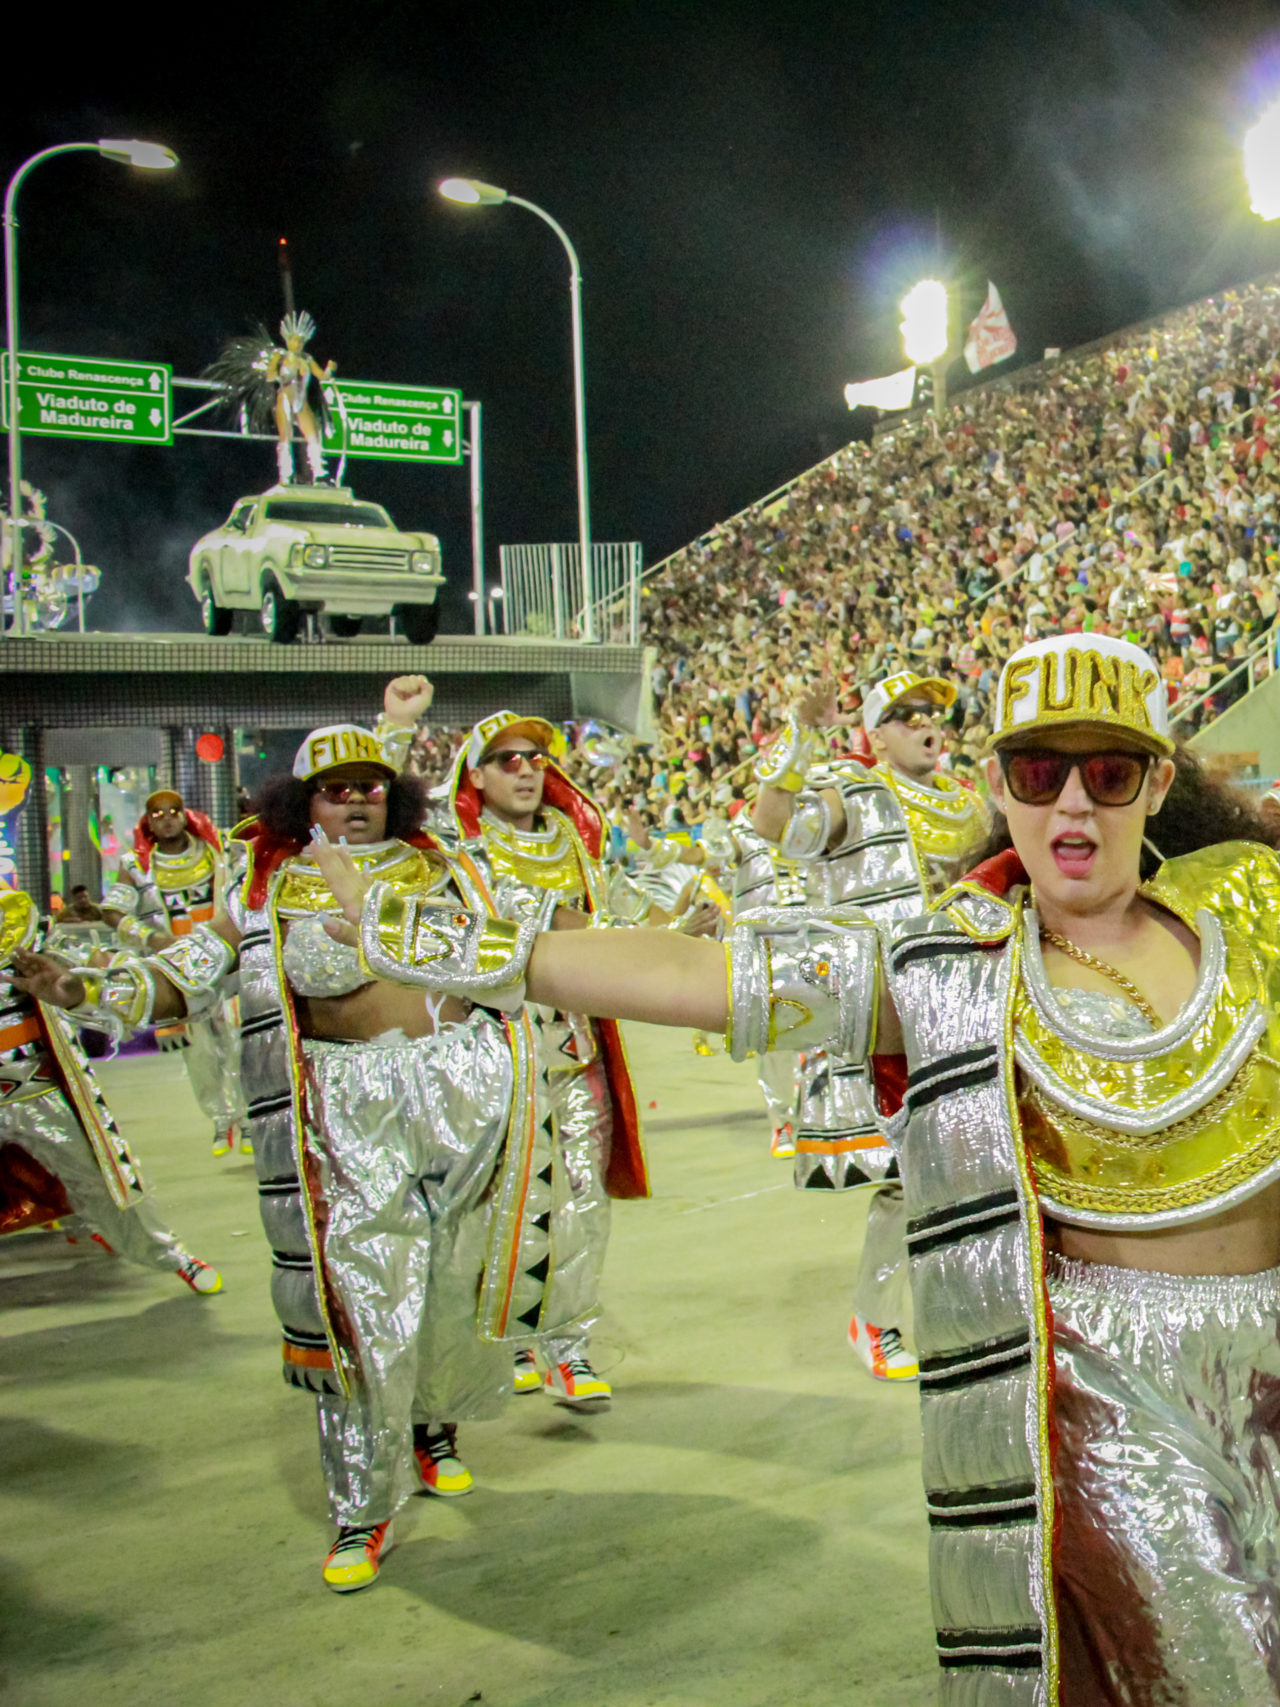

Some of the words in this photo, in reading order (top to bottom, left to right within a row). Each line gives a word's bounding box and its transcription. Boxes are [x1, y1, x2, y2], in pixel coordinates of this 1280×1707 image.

[27, 365, 65, 379] Clube
[67, 369, 144, 387] Renascença
[36, 392, 109, 412] Viaduto
[113, 399, 136, 415] de
[339, 392, 371, 404] Clube
[373, 395, 439, 411] Renascença
[40, 409, 134, 431] Madureira
[347, 417, 408, 435] Viaduto
[412, 422, 431, 436] de
[350, 432, 430, 451] Madureira
[1002, 647, 1159, 730] FUNK
